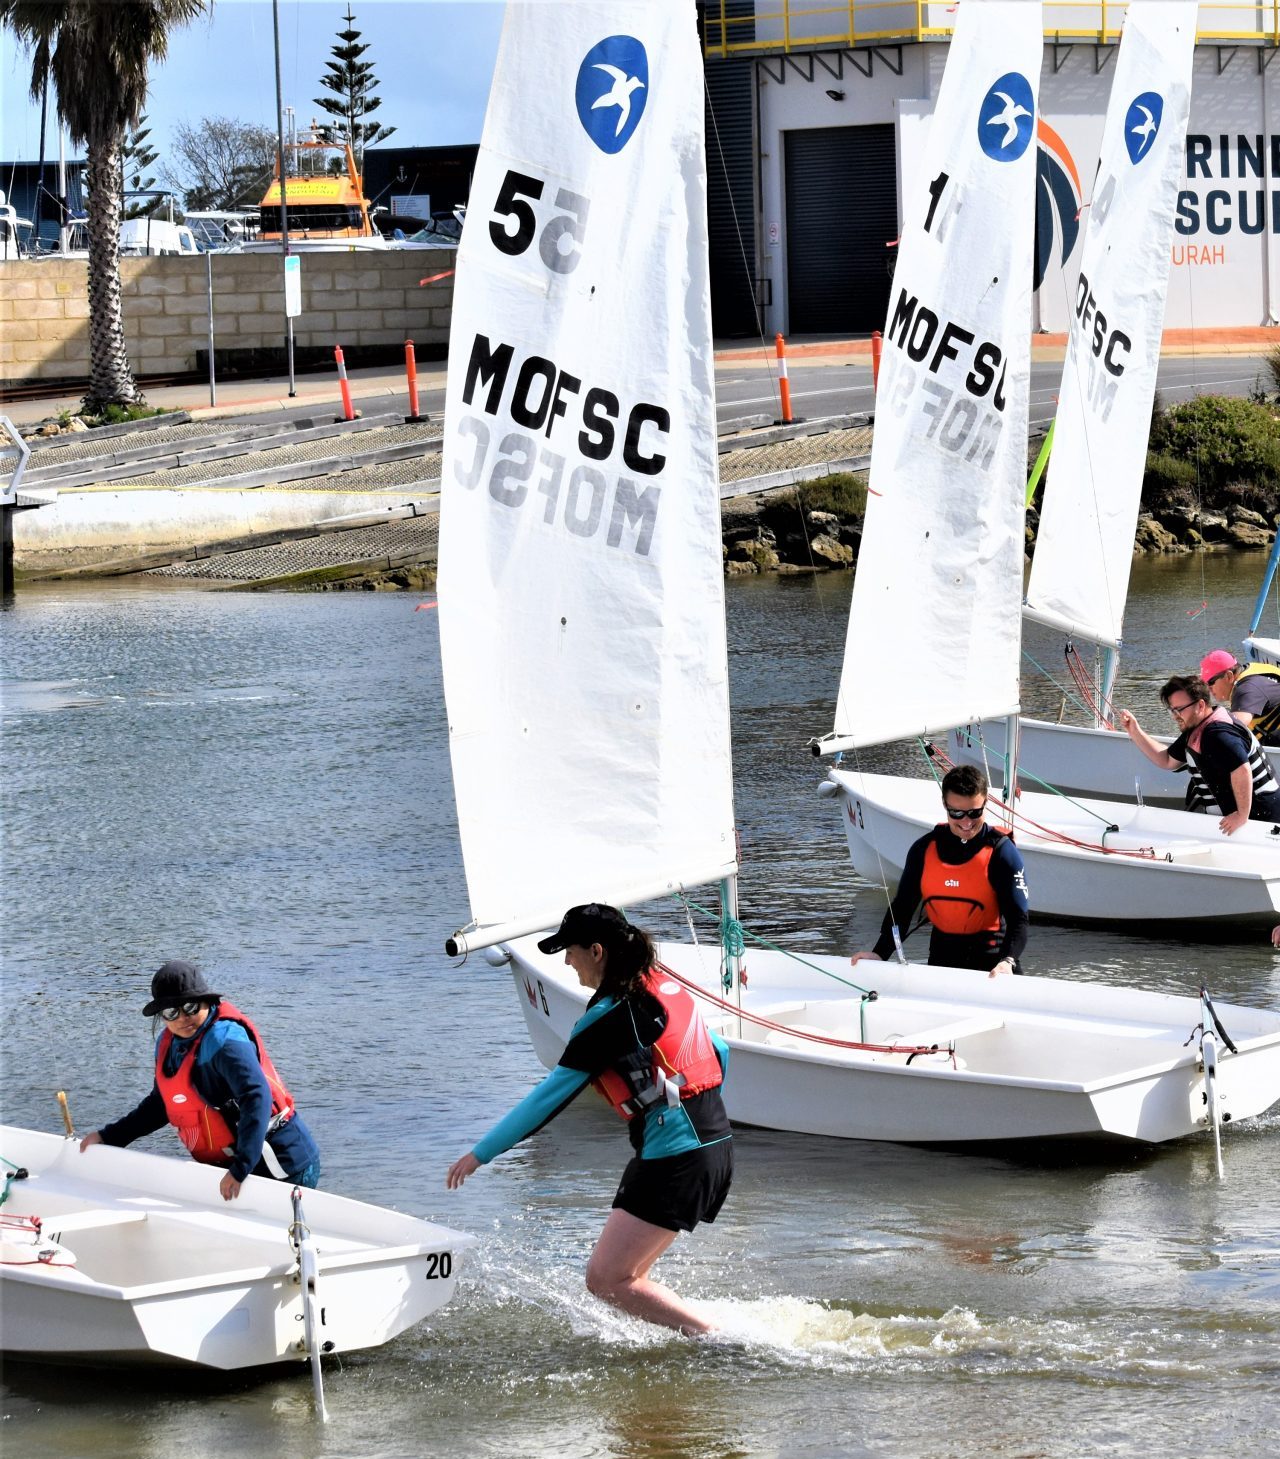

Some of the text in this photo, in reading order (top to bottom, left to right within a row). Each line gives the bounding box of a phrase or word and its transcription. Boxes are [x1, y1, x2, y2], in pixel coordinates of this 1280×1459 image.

[488, 169, 545, 257] 5
[923, 171, 950, 234] 1
[1172, 245, 1225, 266] URAH
[1076, 271, 1132, 377] OFSC
[462, 333, 671, 477] MOFSC
[537, 979, 550, 1017] 6
[425, 1252, 452, 1280] 20
